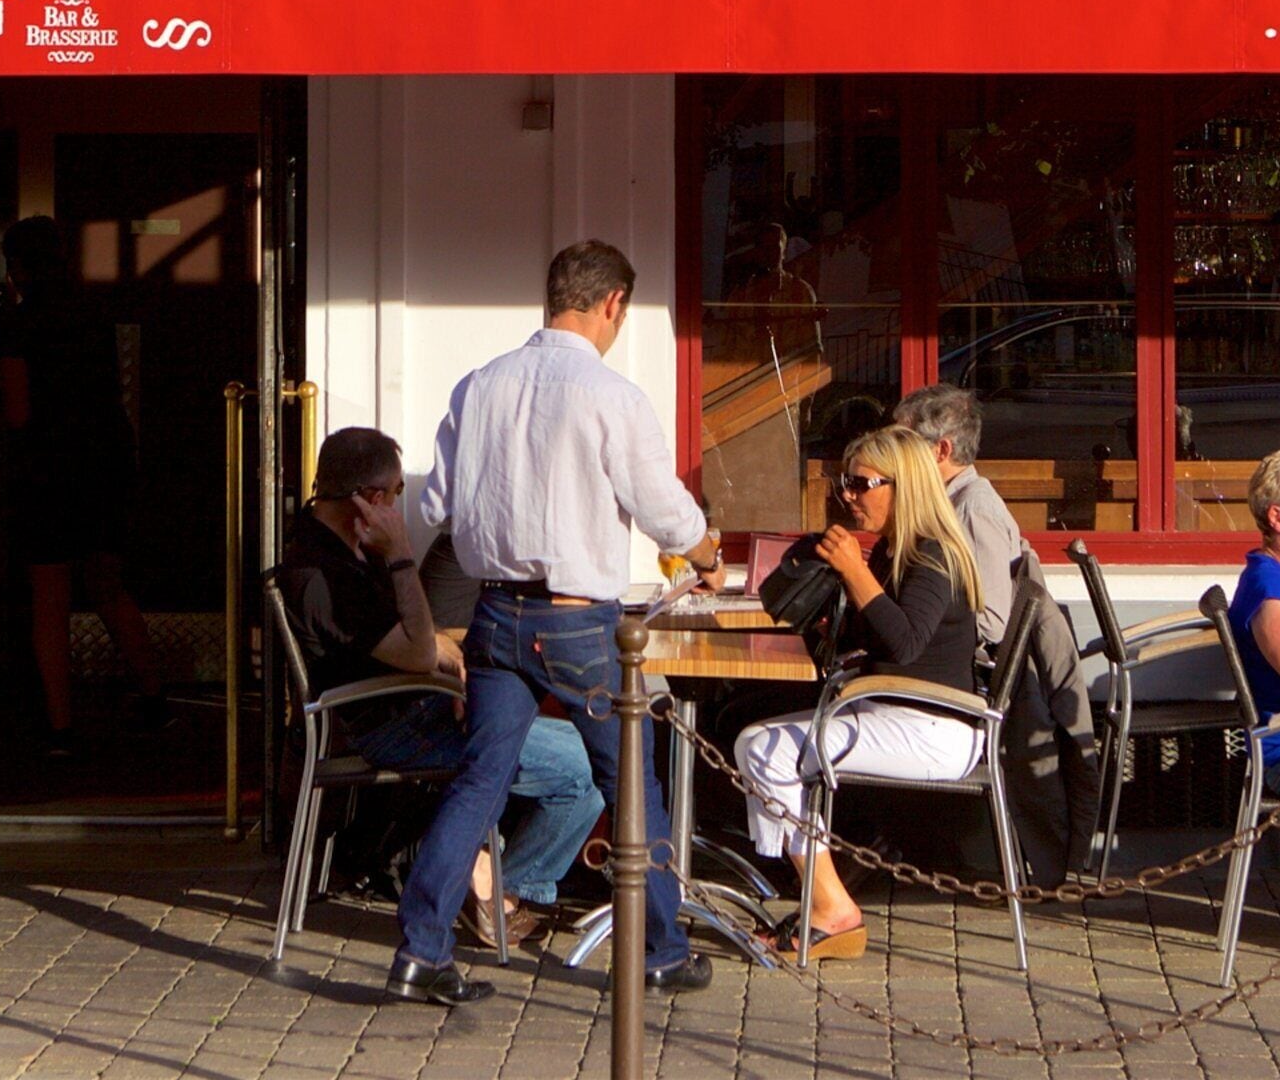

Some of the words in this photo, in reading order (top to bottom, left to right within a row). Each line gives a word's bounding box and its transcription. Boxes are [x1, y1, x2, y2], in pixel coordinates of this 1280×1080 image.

[44, 6, 76, 27] BAR
[81, 7, 99, 27] &
[26, 25, 118, 46] BRASSERIE
